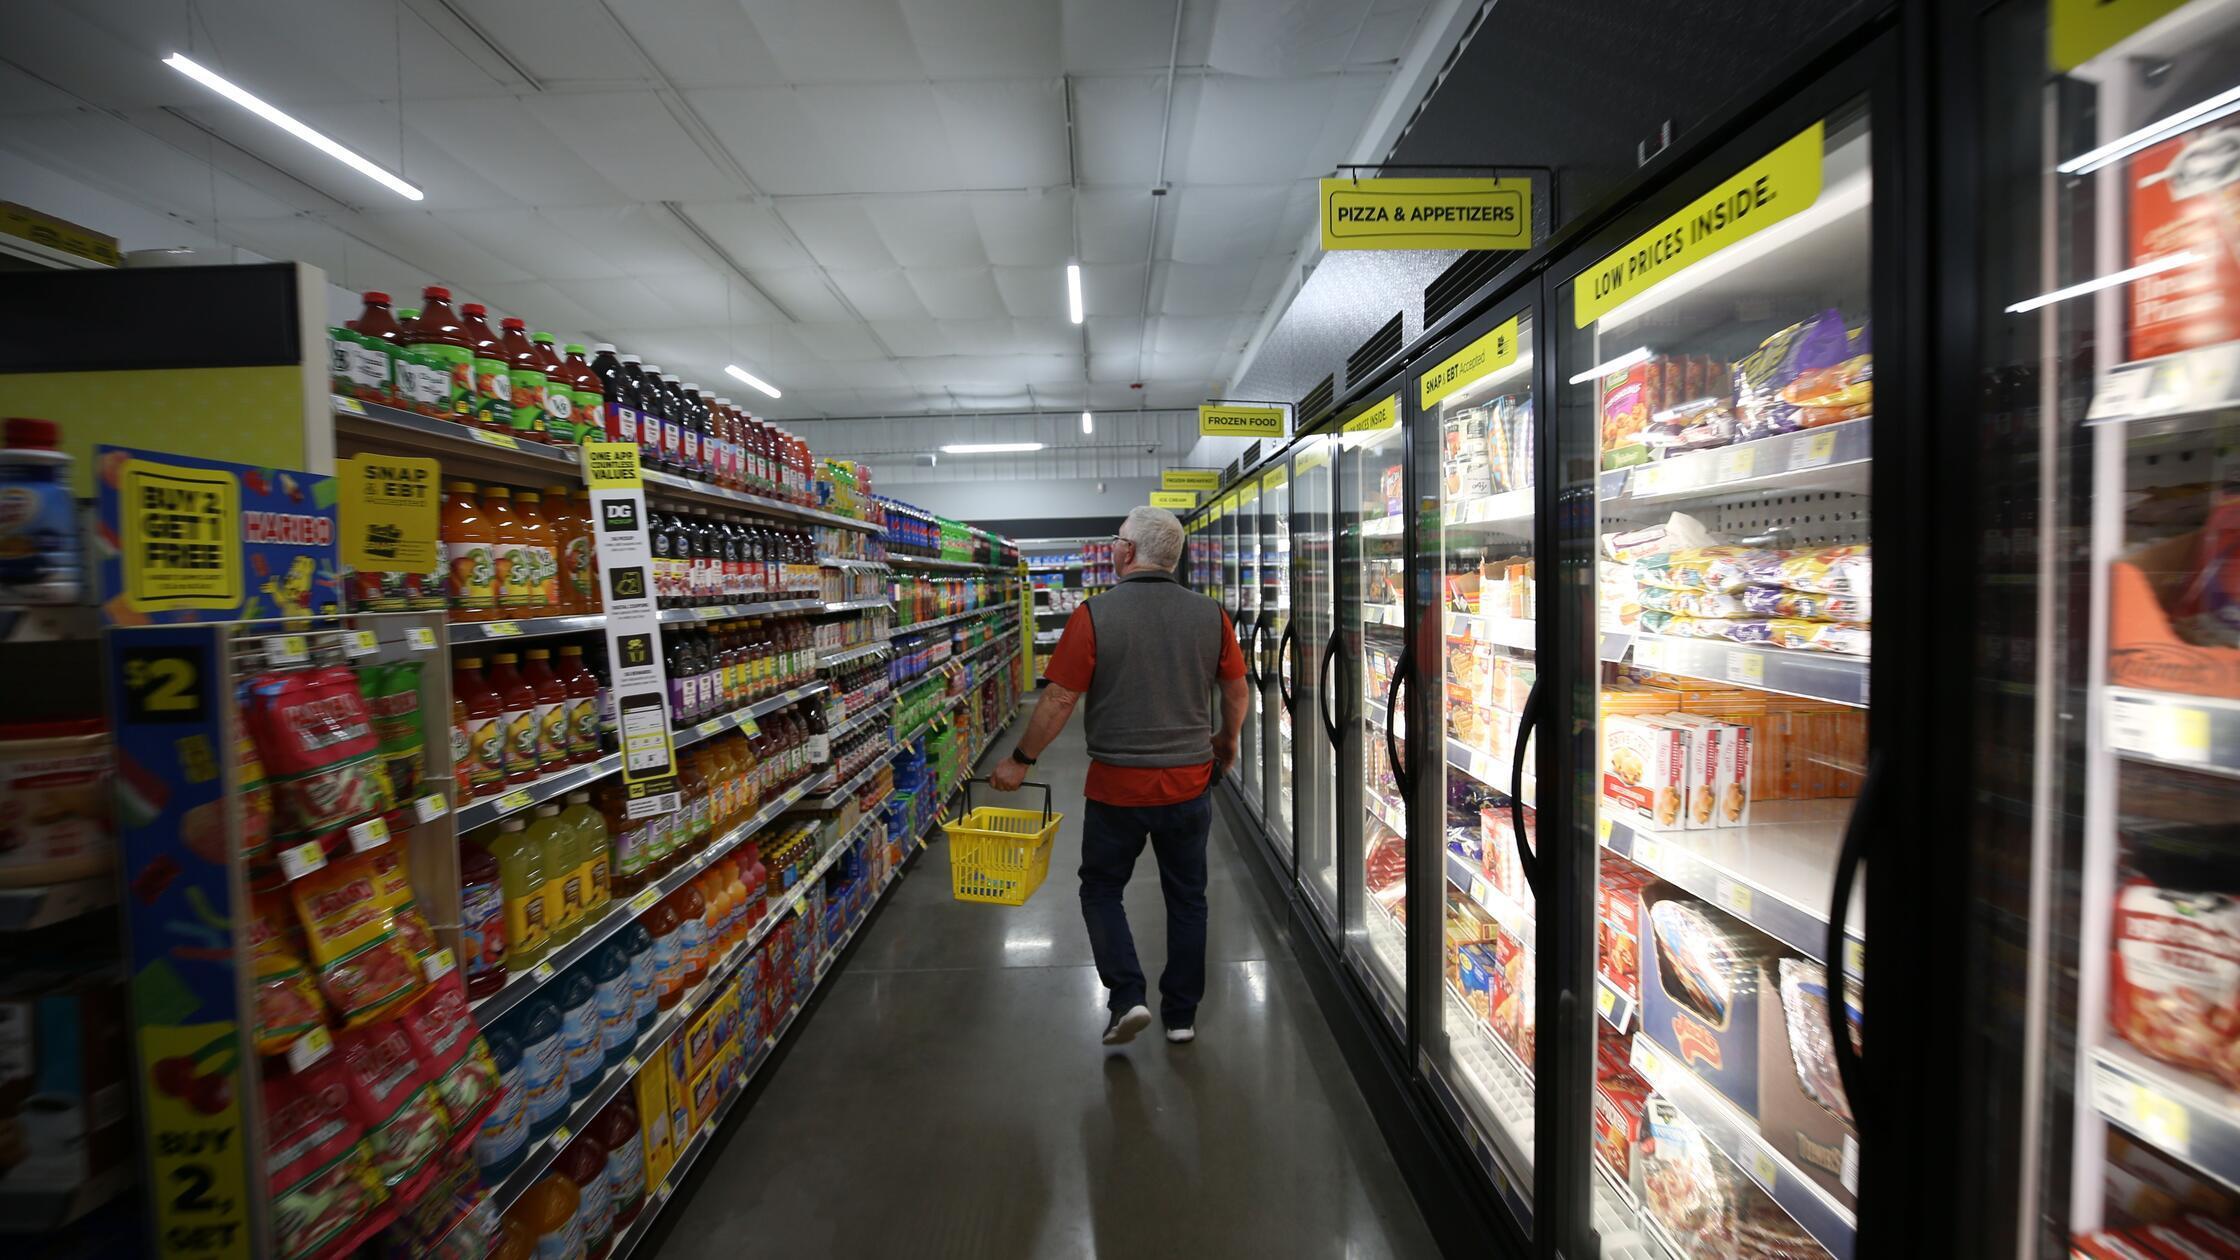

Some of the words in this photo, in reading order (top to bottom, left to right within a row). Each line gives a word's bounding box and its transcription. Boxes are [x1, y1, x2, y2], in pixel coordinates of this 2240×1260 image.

[1338, 206, 1389, 222] PIZZA
[1394, 206, 1406, 222] &
[1410, 206, 1514, 222] APPETIZERS
[1594, 262, 1624, 300] LOW
[1628, 226, 1684, 281] PRICES
[1426, 374, 1443, 394] SNAP
[1446, 363, 1460, 384] EBT
[1459, 350, 1486, 374] Accepted
[1208, 416, 1247, 426] FROZEN
[1250, 416, 1277, 427] FOOD
[589, 452, 611, 461] ONE
[613, 451, 634, 461] APP
[591, 461, 635, 469] COUNTLESS
[364, 465, 429, 481] SNAP
[142, 485, 198, 510] BUY
[383, 482, 429, 498] EBT
[606, 504, 632, 518] DG
[144, 513, 199, 540] GET
[207, 516, 223, 541] 1
[243, 511, 335, 546] HARIBO
[143, 542, 223, 569] FREE
[156, 1125, 236, 1155] BUY
